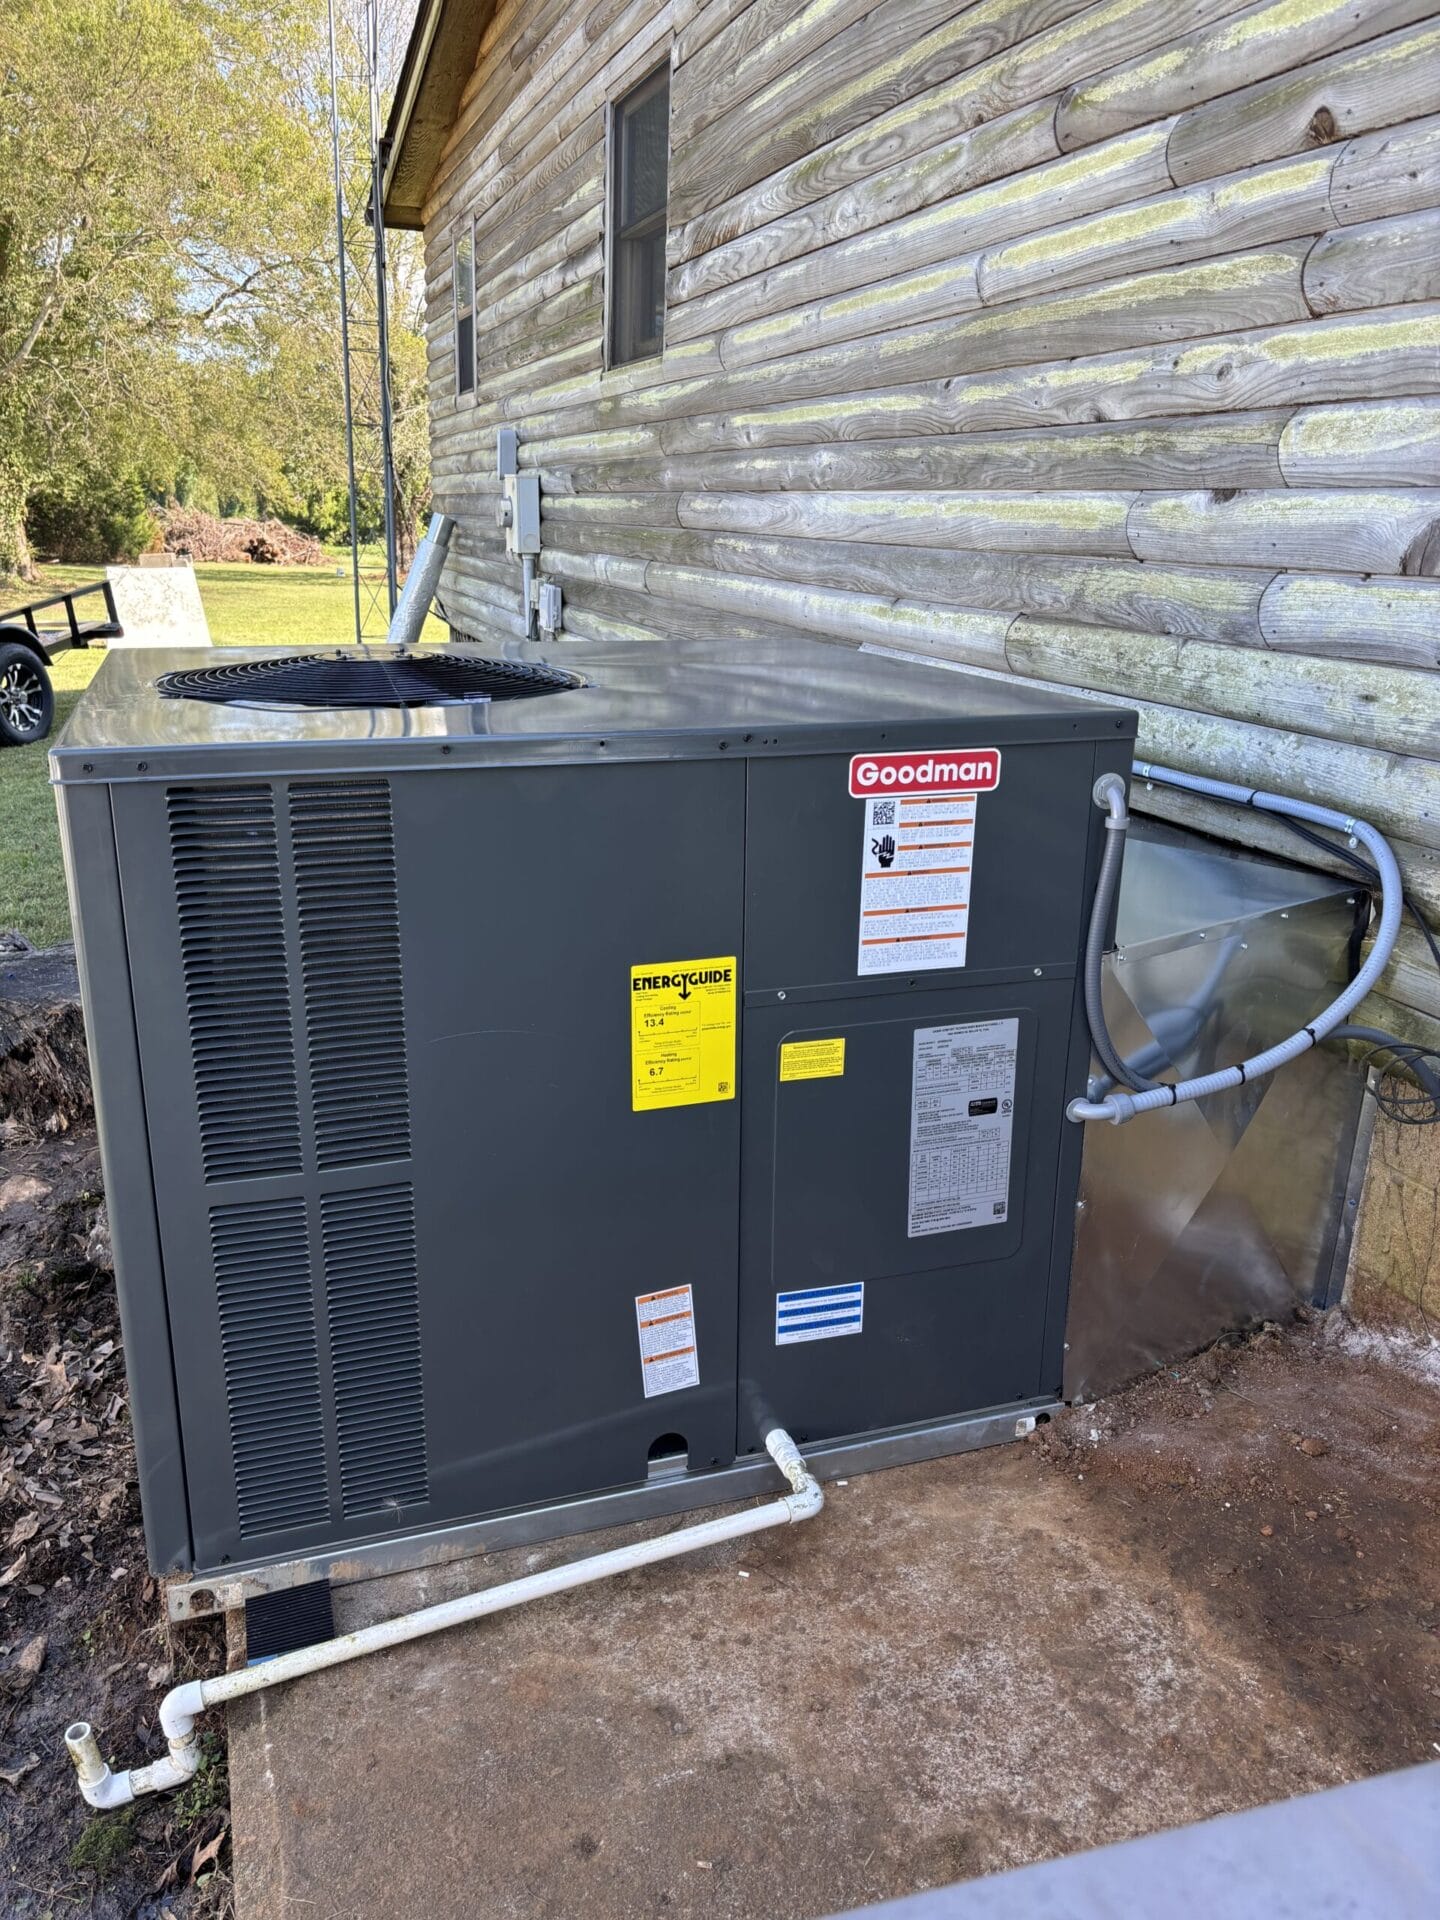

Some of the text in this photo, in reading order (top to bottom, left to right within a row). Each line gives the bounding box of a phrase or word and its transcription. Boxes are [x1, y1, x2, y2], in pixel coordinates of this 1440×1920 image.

[856, 760, 992, 786] Goodman
[633, 969, 731, 992] ENERGYGUIDE
[645, 1018, 664, 1028] 13.4
[649, 1067, 664, 1077] 6.7
